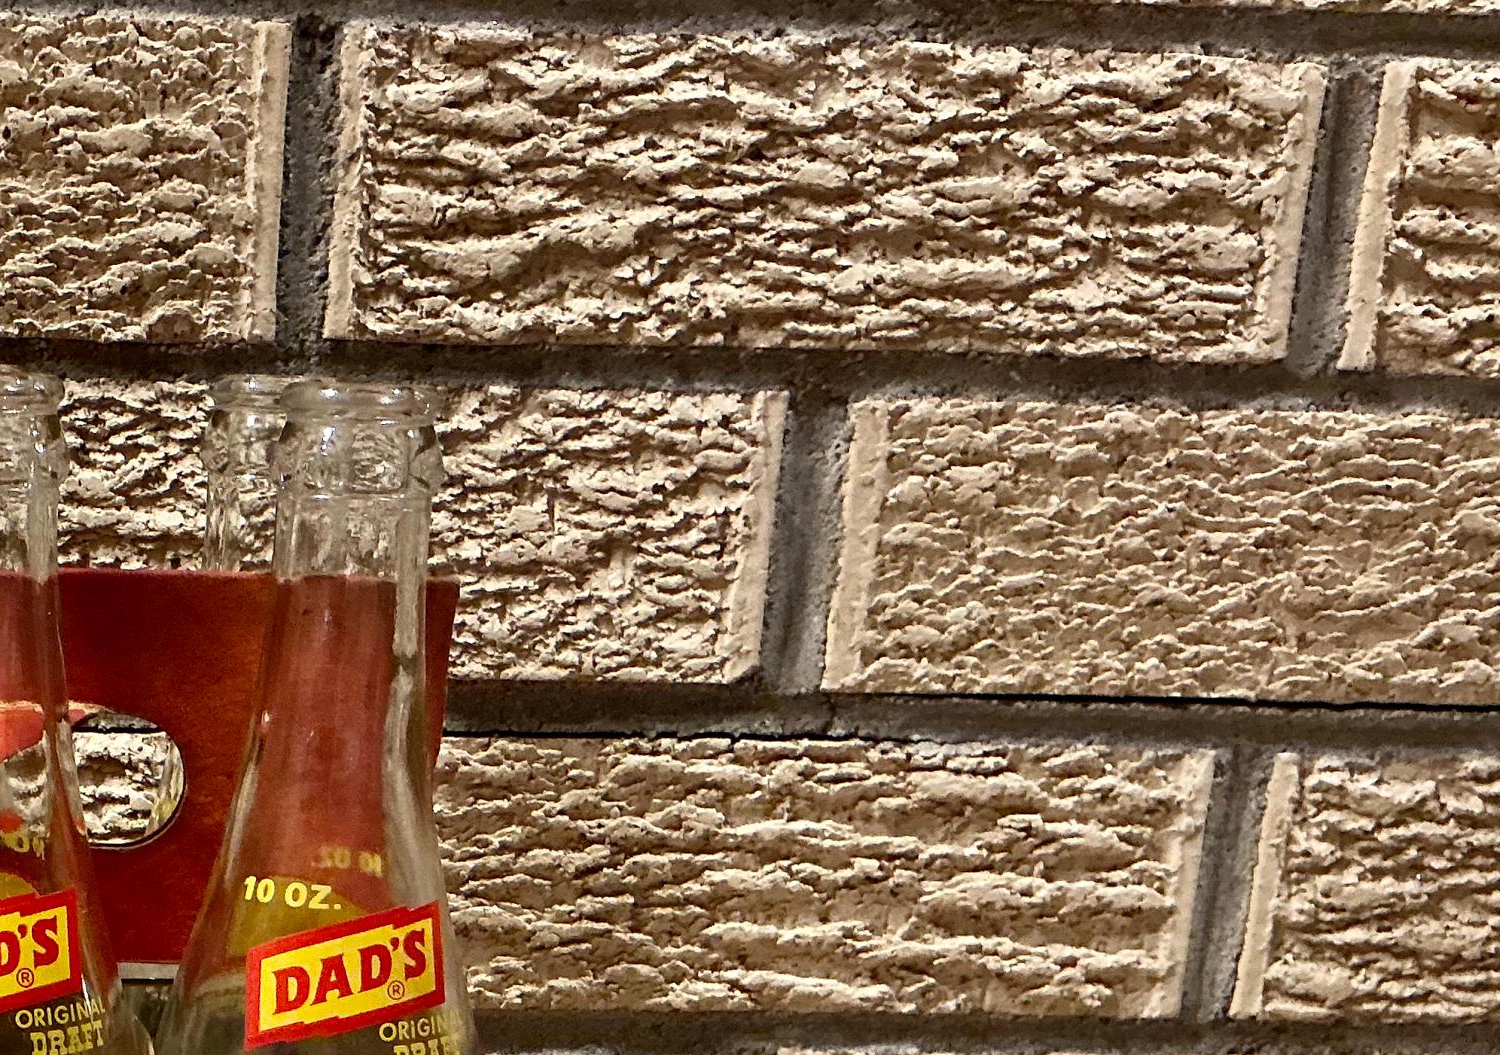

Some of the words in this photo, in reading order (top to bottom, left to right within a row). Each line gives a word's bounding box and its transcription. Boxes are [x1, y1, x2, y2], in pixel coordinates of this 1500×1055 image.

[244, 876, 276, 903] 10
[285, 882, 341, 910] OZ.
[273, 928, 427, 1015] DAD'S
[15, 996, 106, 1029] ORIGINAL
